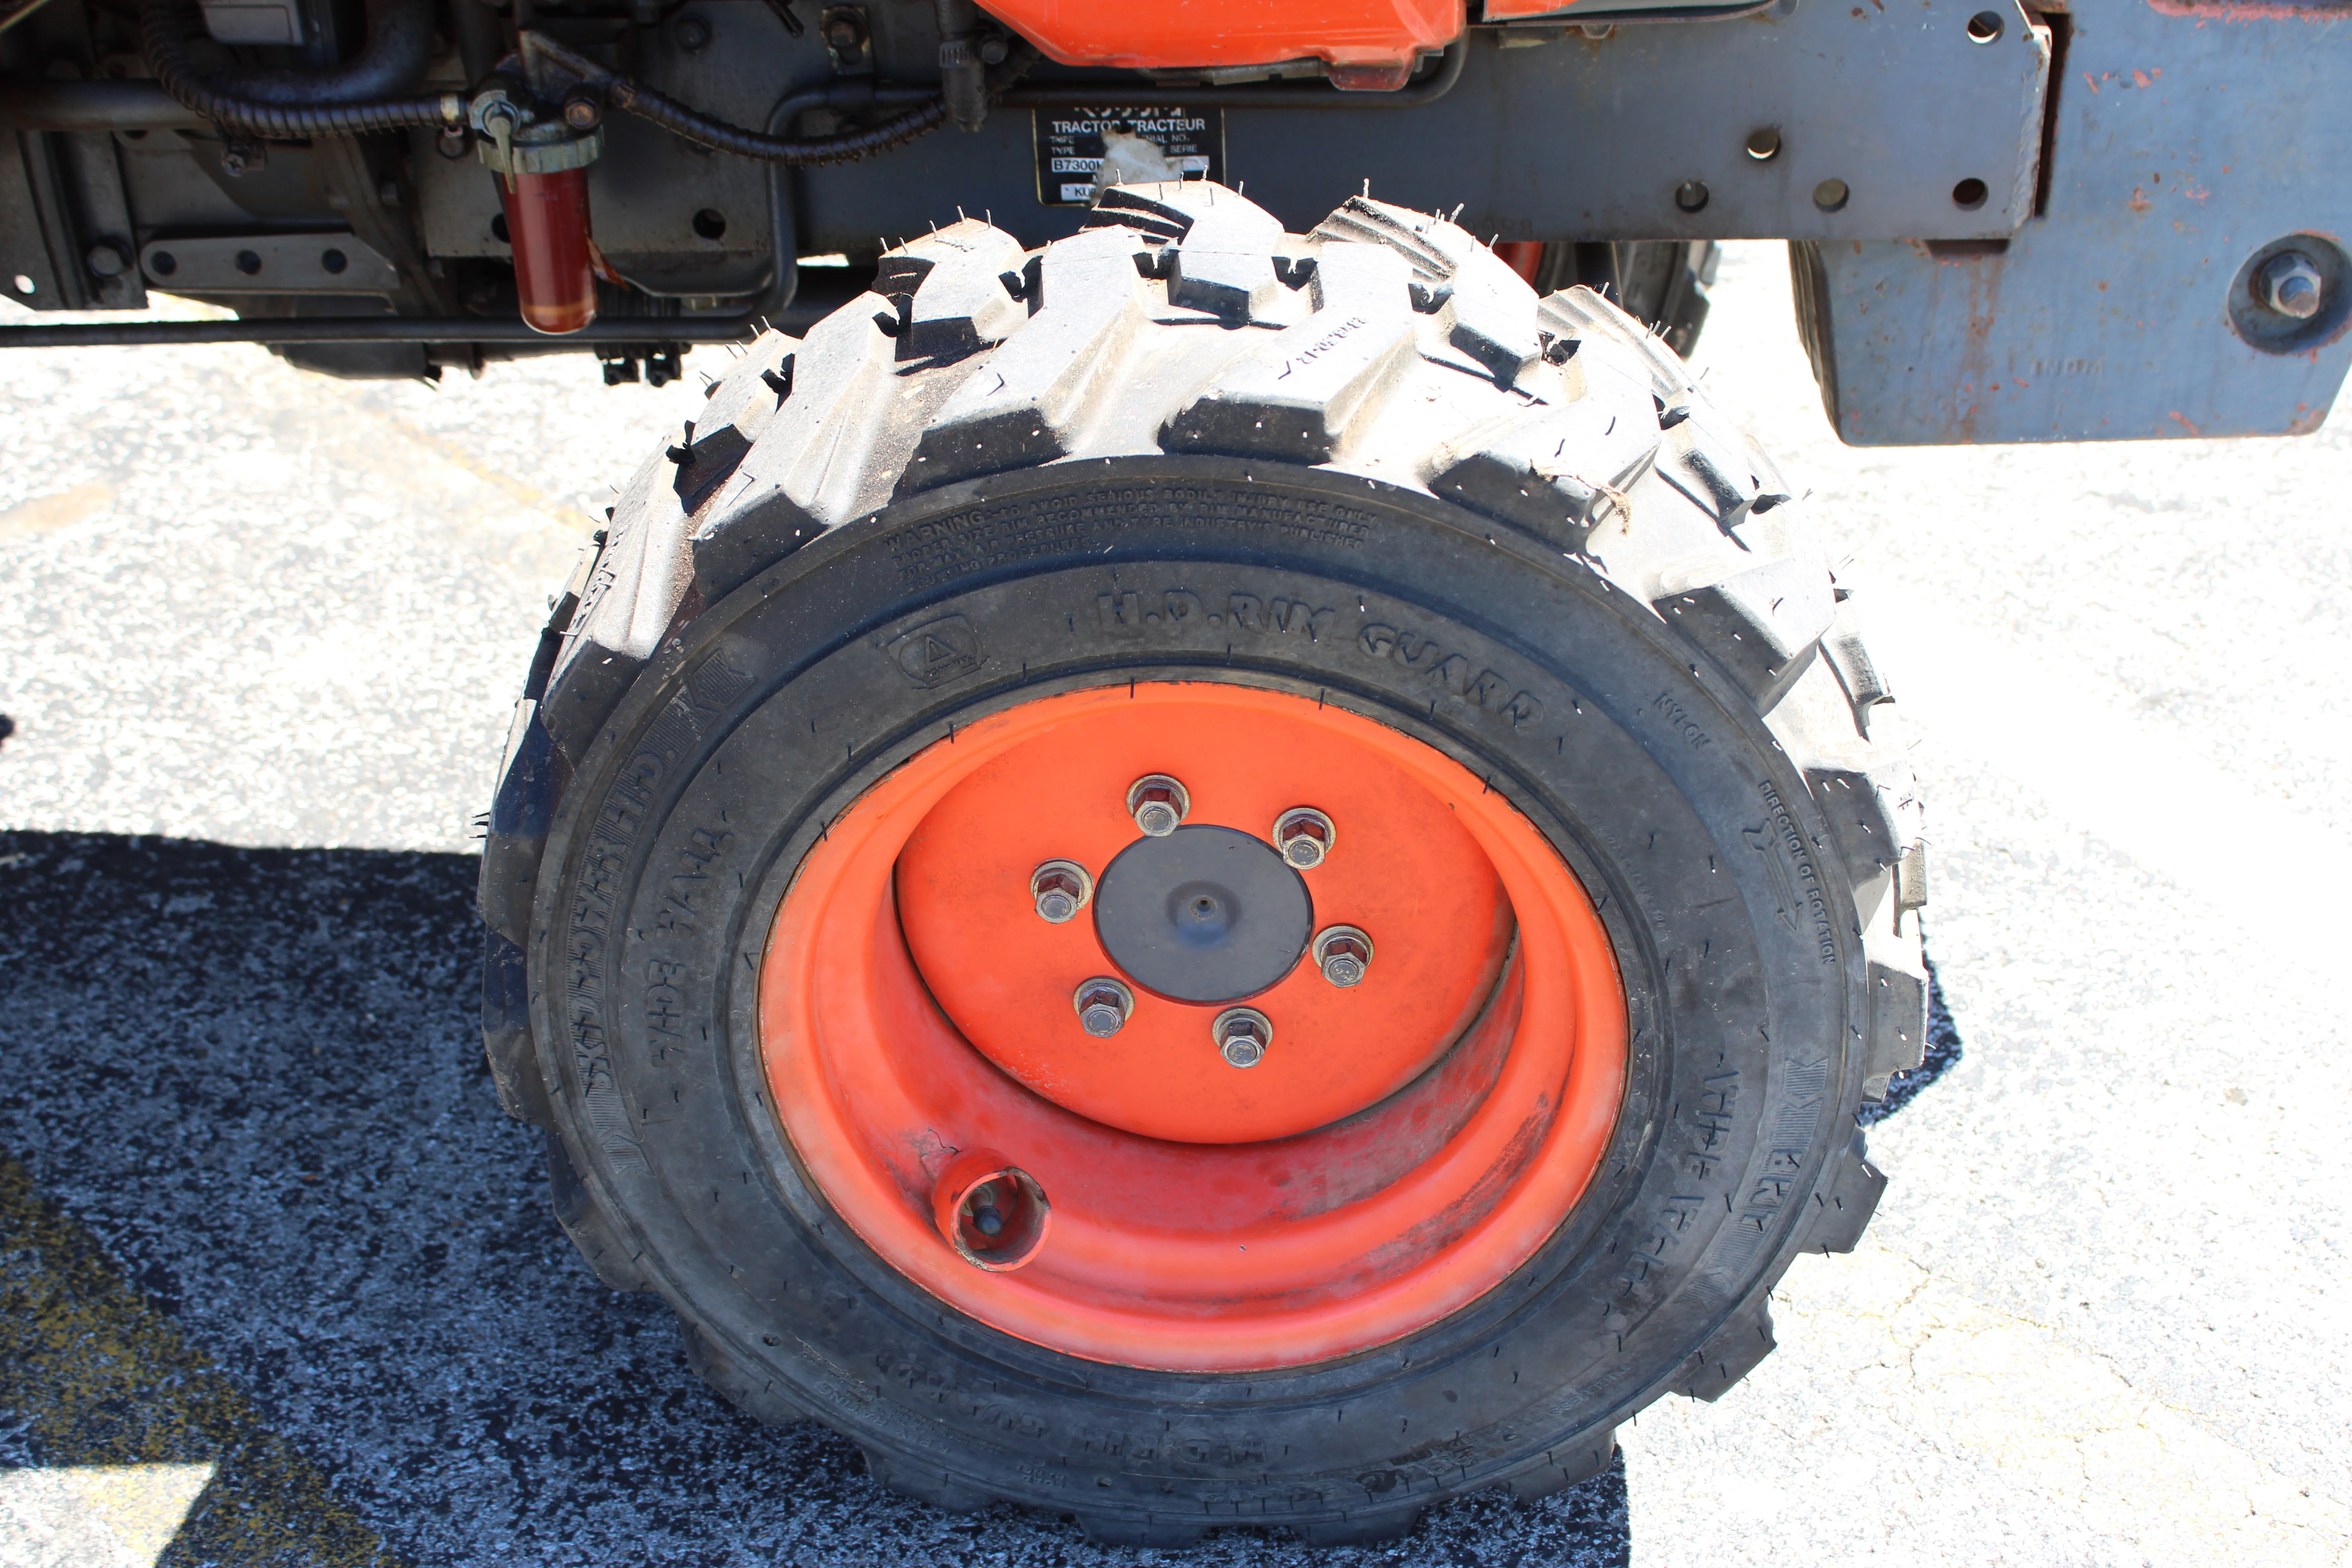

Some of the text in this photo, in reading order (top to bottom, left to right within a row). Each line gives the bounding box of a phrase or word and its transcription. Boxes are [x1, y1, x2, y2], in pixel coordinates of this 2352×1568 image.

[891, 537, 951, 565] PROPER
[956, 524, 995, 545] SIZE
[1001, 517, 1029, 533] RIM
[1037, 503, 1157, 524] RECOMMENDED
[1200, 503, 1229, 515] RIM
[1237, 505, 1371, 535] MANUFACTURER
[1028, 495, 1079, 514] AVOID
[1085, 487, 1155, 505] SERIOUS
[1162, 488, 1223, 501] BODILY
[1231, 490, 1289, 507] INJURY
[1296, 497, 1329, 514] USE
[1334, 505, 1377, 524] ONLY
[898, 560, 927, 580] FOR
[972, 539, 1000, 554] AIR
[1007, 521, 1086, 545] PRESSURE
[1092, 517, 1124, 532] AND
[1129, 515, 1172, 530] TYRE
[1279, 523, 1365, 551] PUBLISHED
[1356, 621, 1546, 729] GUARD
[1656, 693, 1711, 751] NYLON
[1759, 780, 1836, 966] DIRECTION OF ROTATION
[570, 832, 624, 992] POWER
[646, 825, 734, 1068] WIDE WALL
[1612, 1071, 1741, 1296] WIDE WALL
[1743, 1149, 1802, 1232] BKT
[812, 1380, 891, 1429] RATING
[884, 1358, 1045, 1438] GUARD
[892, 1424, 936, 1449] PLY
[1012, 1462, 1067, 1481] RANGE
[1020, 1473, 1066, 1490] LOAD
